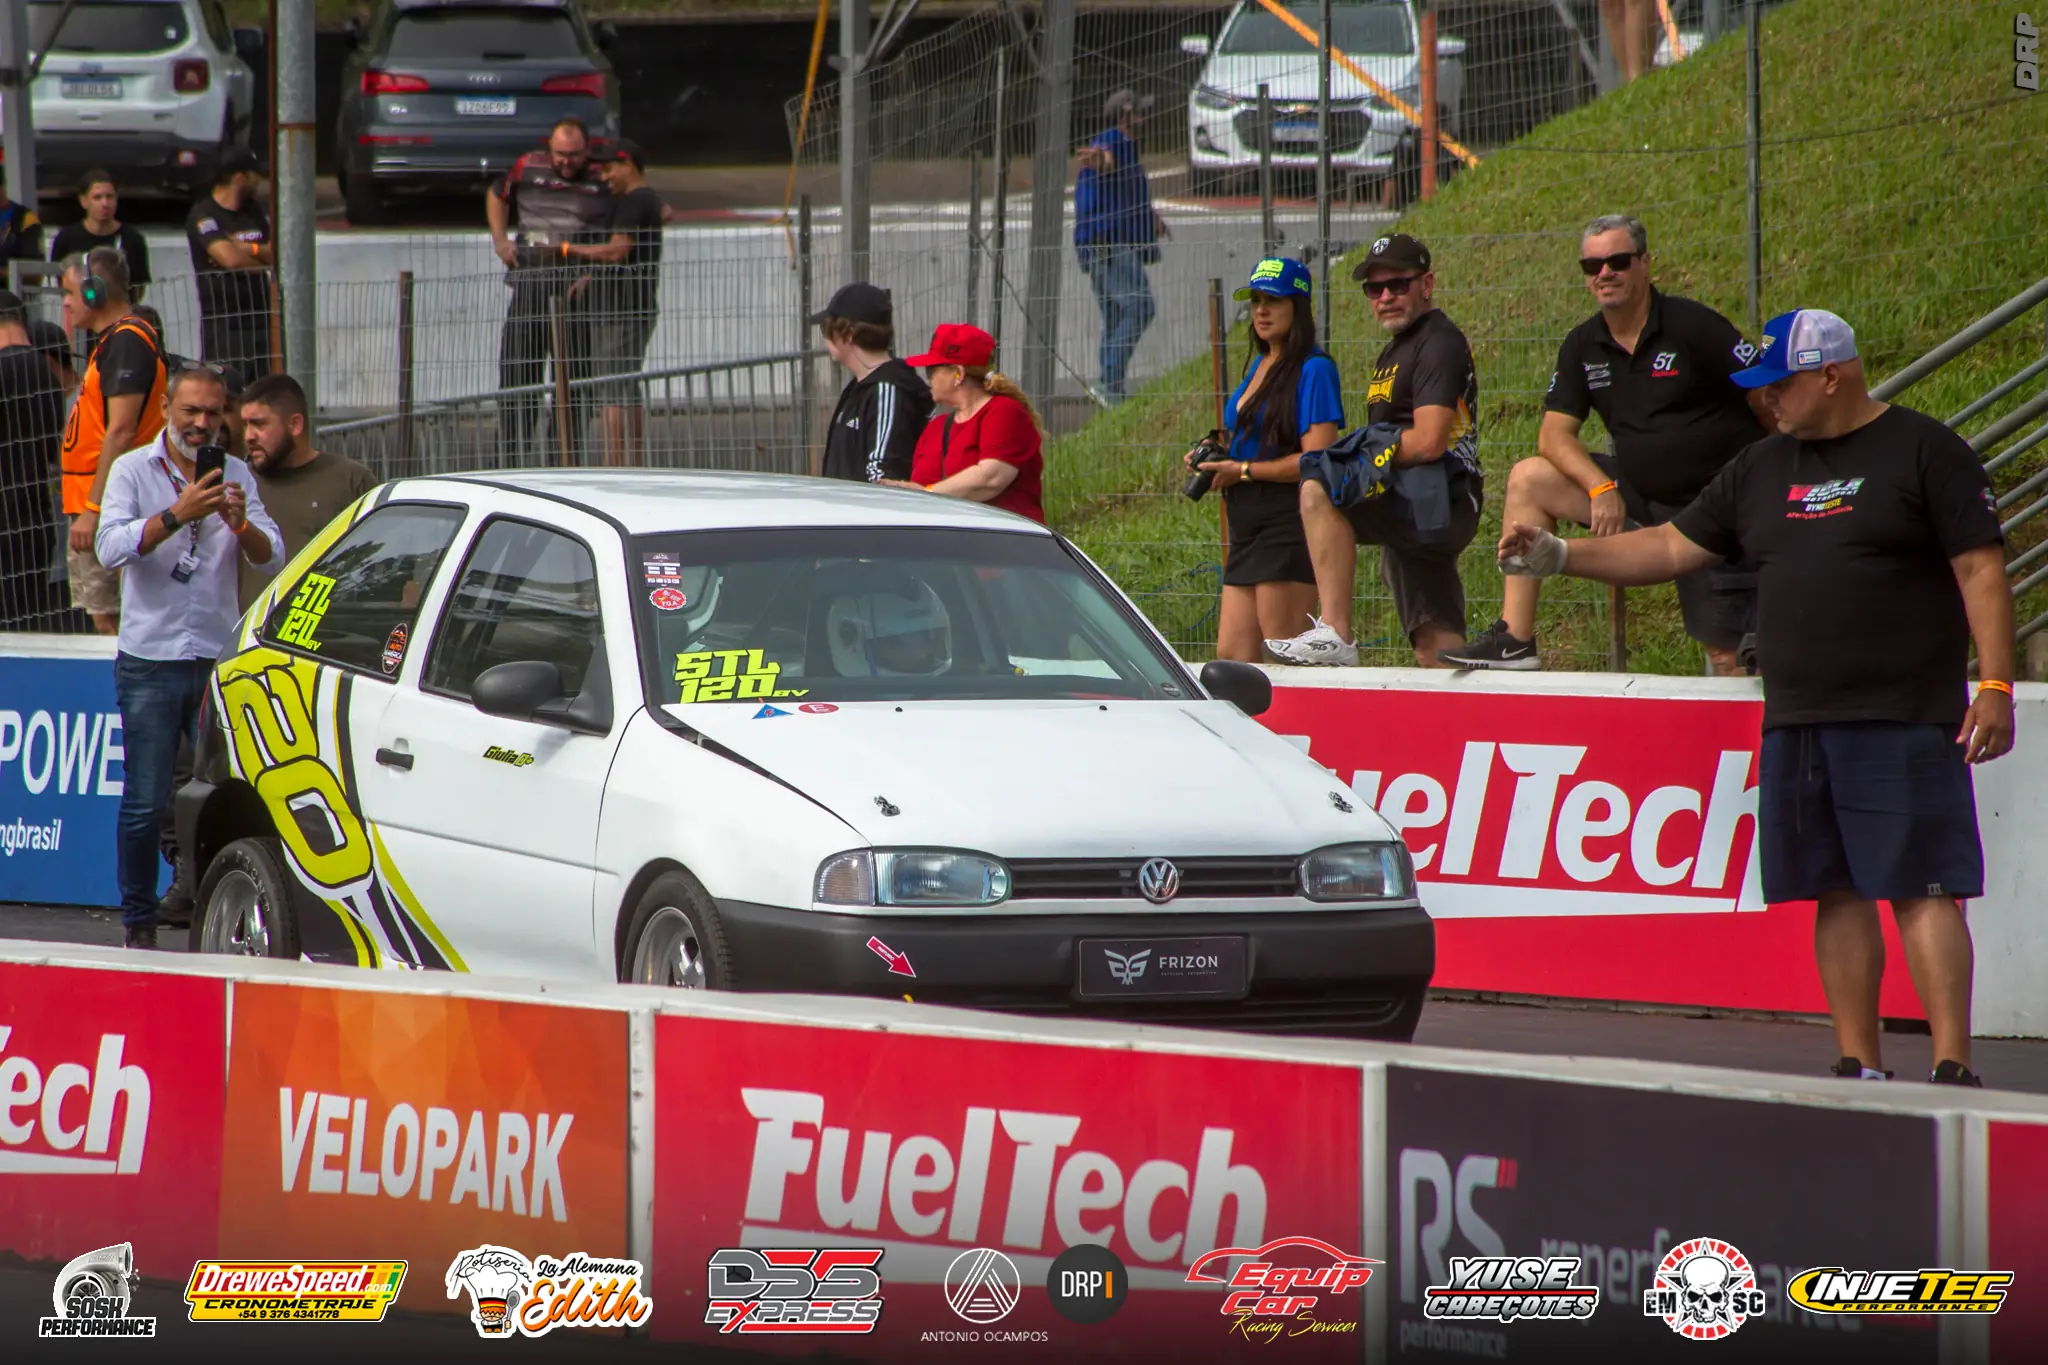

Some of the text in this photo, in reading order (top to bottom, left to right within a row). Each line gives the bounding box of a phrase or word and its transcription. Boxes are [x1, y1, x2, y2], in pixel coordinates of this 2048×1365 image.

[1653, 353, 1677, 371] 57
[291, 572, 336, 616] STL
[276, 607, 323, 648] 120
[675, 649, 781, 681] STL
[680, 674, 777, 704] 120
[0, 709, 125, 796] POWE
[483, 745, 519, 764] Giulia
[1278, 735, 1768, 911] elTech
[1159, 955, 1218, 969] FRIZON
[0, 1026, 151, 1175] ech
[279, 1086, 574, 1223] VELOPARK
[740, 1086, 1268, 1290] FuelTech
[1399, 1147, 1506, 1304] RS
